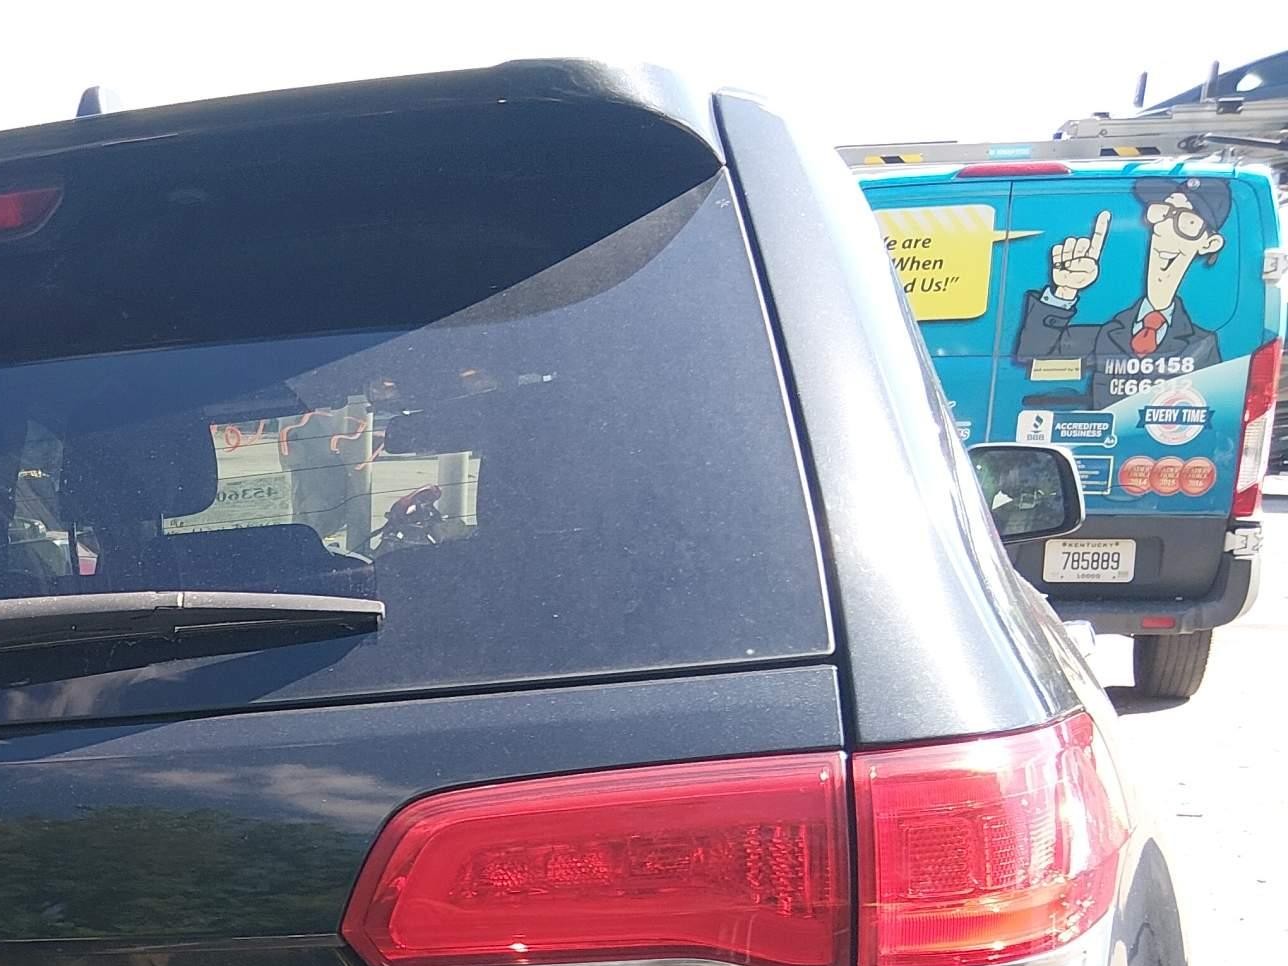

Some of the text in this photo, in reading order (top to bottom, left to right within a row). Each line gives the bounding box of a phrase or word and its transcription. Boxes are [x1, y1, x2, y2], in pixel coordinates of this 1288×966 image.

[884, 236, 932, 250] e are
[892, 256, 944, 271] When
[1145, 409, 1208, 423] EVERY TIME
[1055, 422, 1109, 430] ACCREDITED
[1062, 552, 1121, 570] 785889
